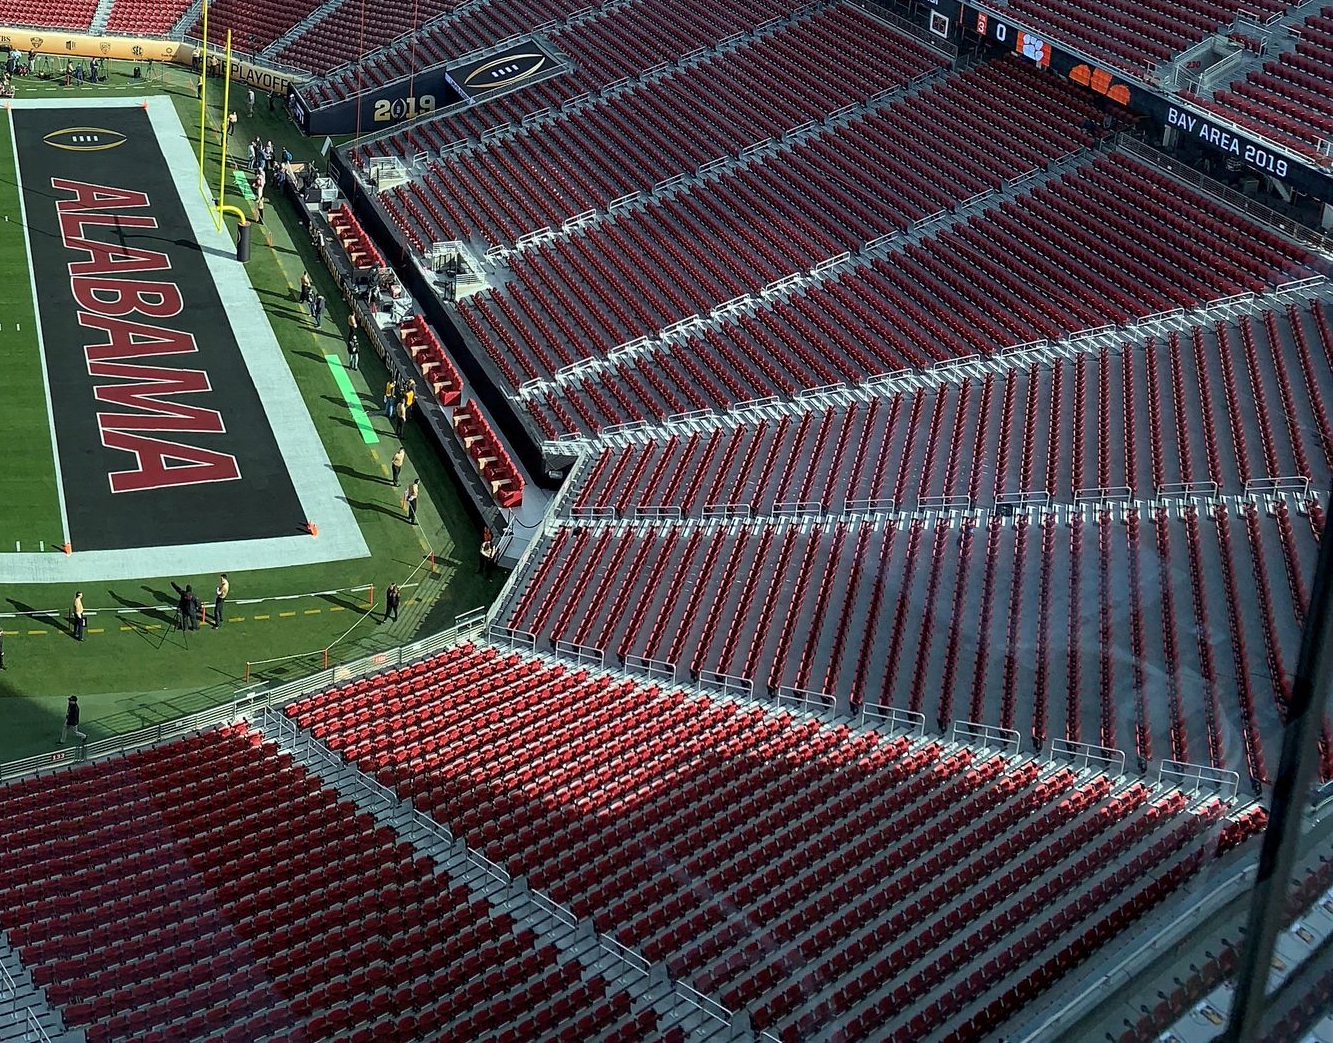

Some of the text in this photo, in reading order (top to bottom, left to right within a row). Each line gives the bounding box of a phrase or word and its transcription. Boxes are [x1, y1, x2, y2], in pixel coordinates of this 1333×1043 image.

[374, 94, 435, 121] 2019
[1168, 107, 1288, 178] BAY AREA 2019
[49, 175, 242, 495] ALABAMA
